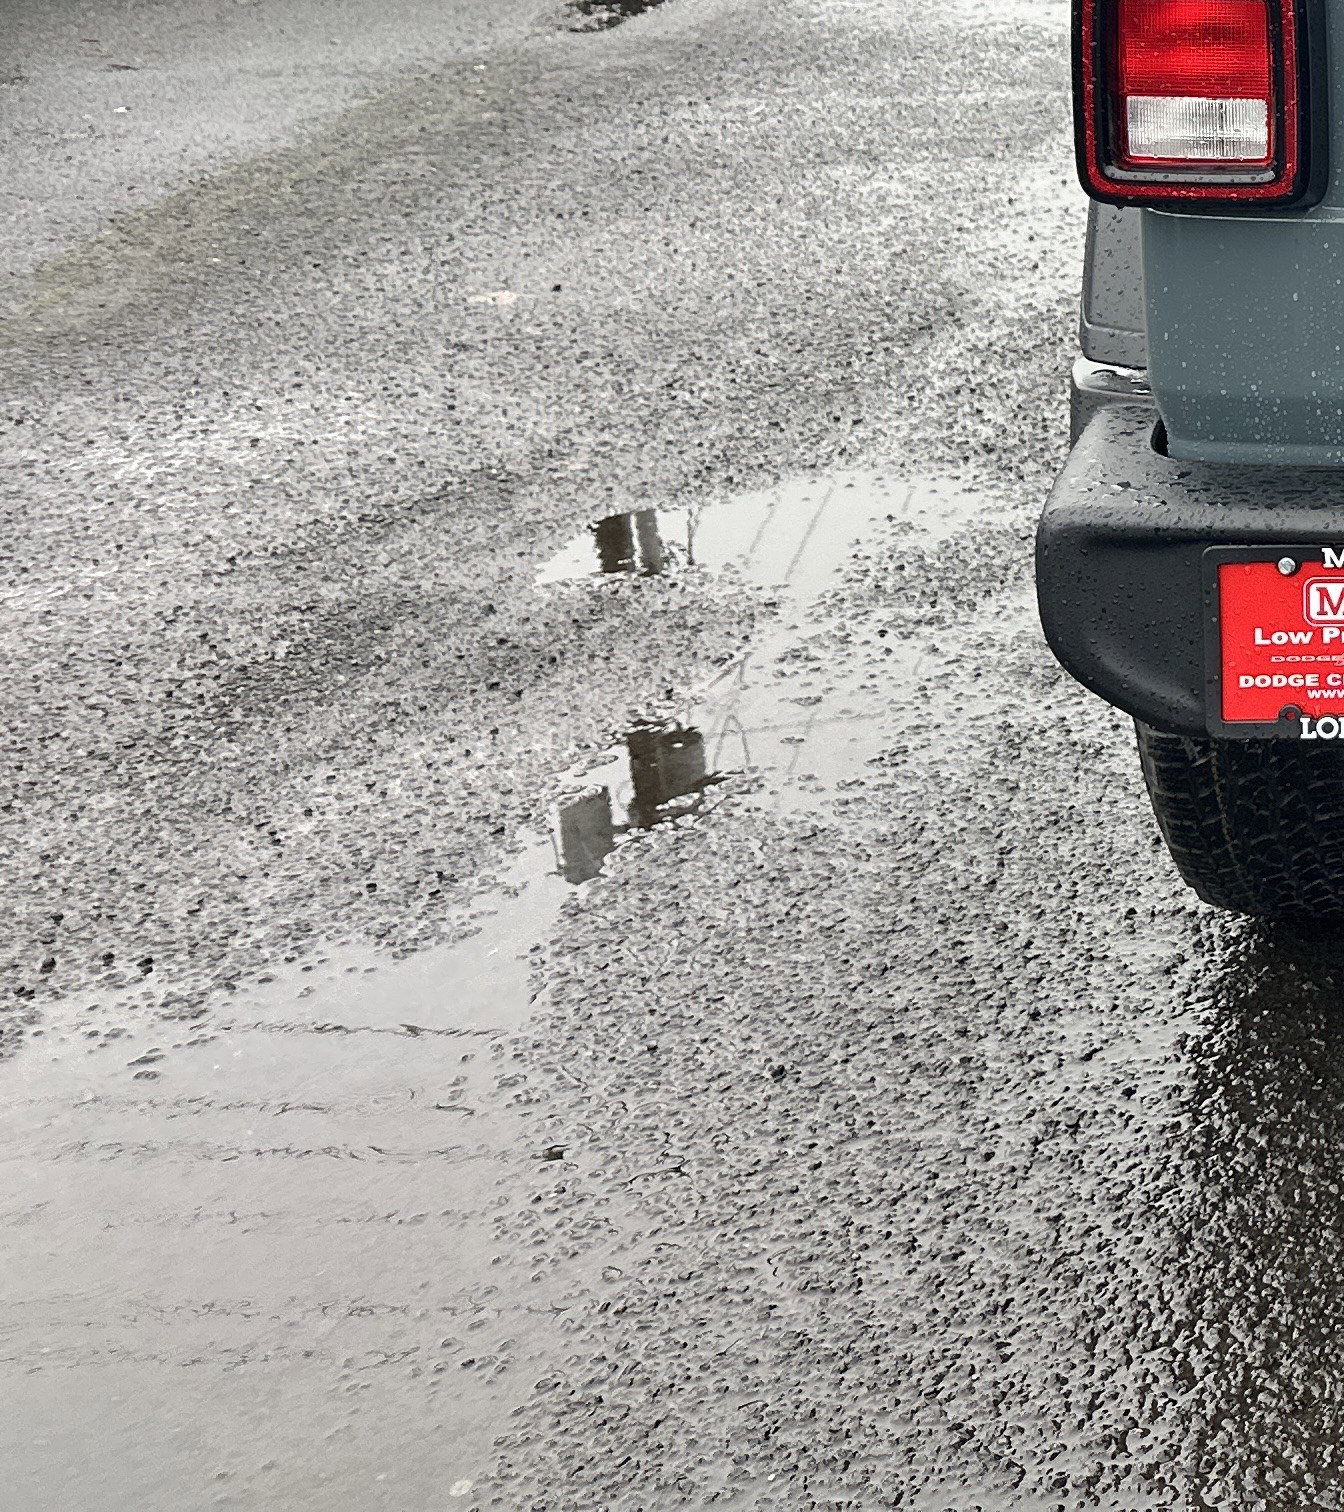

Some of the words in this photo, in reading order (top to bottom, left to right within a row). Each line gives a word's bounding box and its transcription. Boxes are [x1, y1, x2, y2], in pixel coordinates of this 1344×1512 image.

[1254, 627, 1313, 645] Low
[1271, 655, 1341, 663] DODGE
[1239, 674, 1320, 688] DODGE
